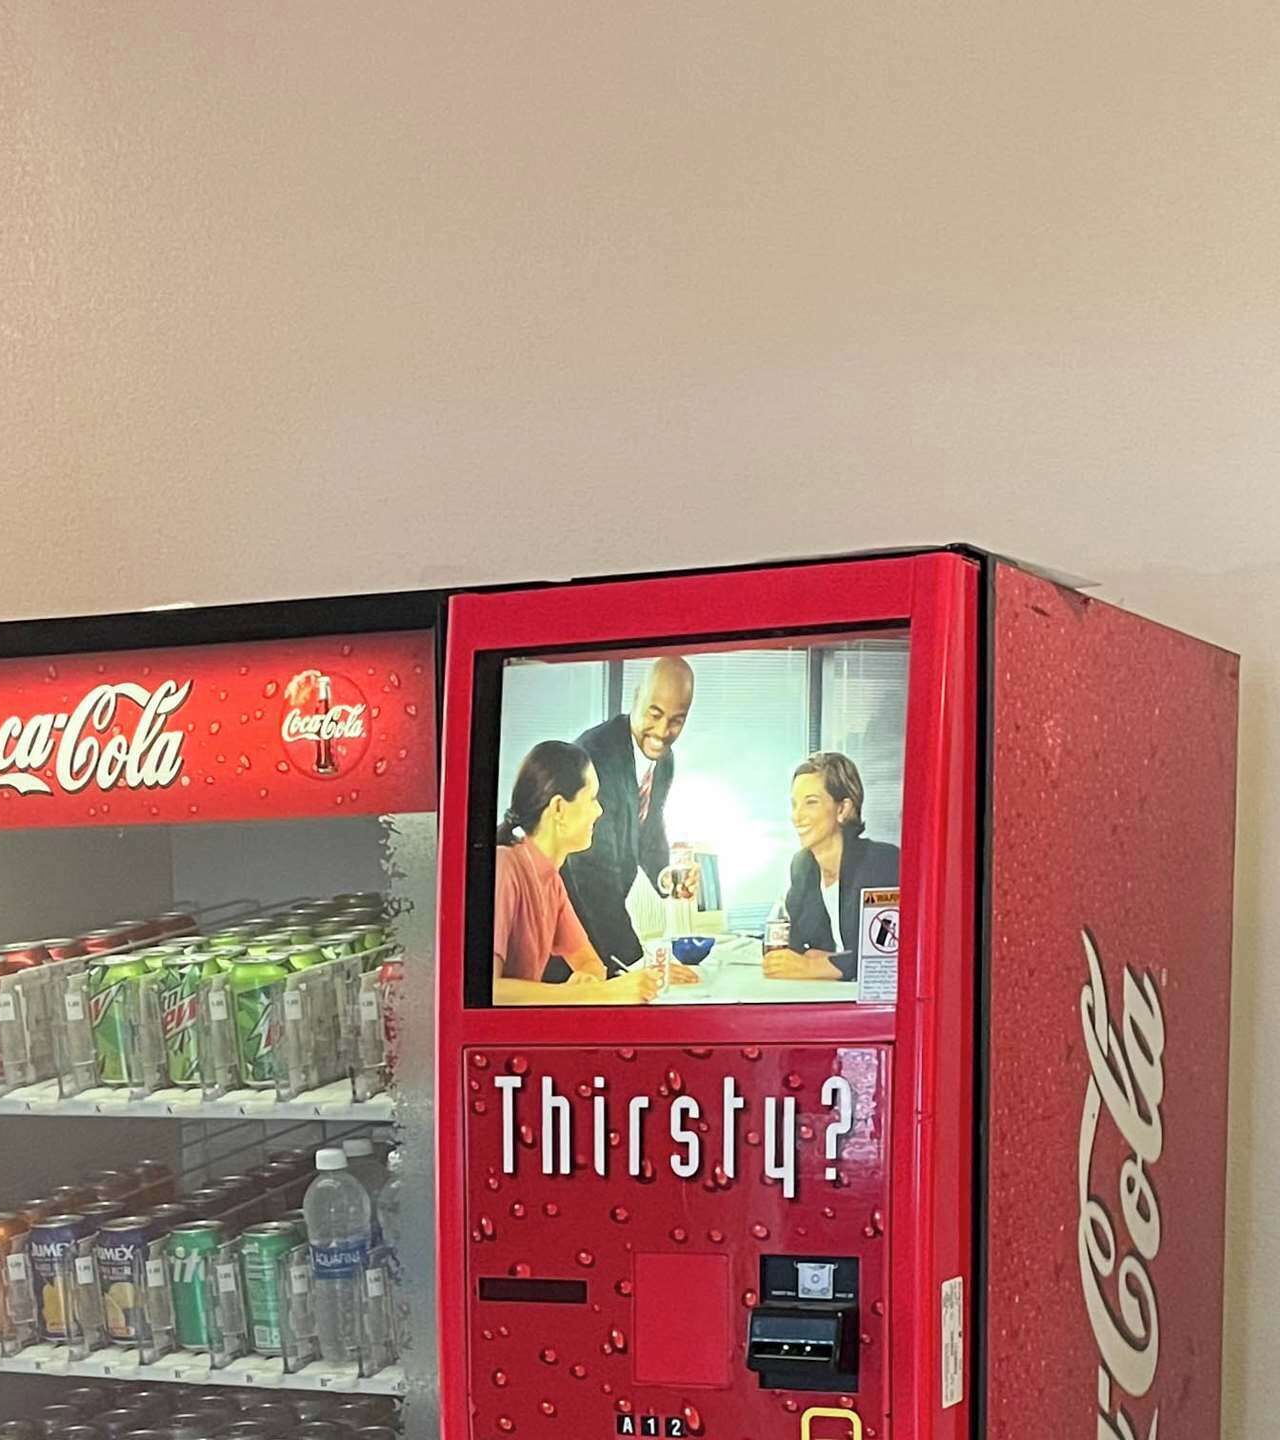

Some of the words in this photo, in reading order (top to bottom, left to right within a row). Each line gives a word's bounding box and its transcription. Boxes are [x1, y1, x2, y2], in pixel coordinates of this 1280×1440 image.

[281, 703, 367, 742] Coca-Cola
[493, 1074, 853, 1200] Thirsty?
[623, 1417, 633, 1434] A
[647, 1418, 655, 1435] 1
[671, 1419, 681, 1436] 2
